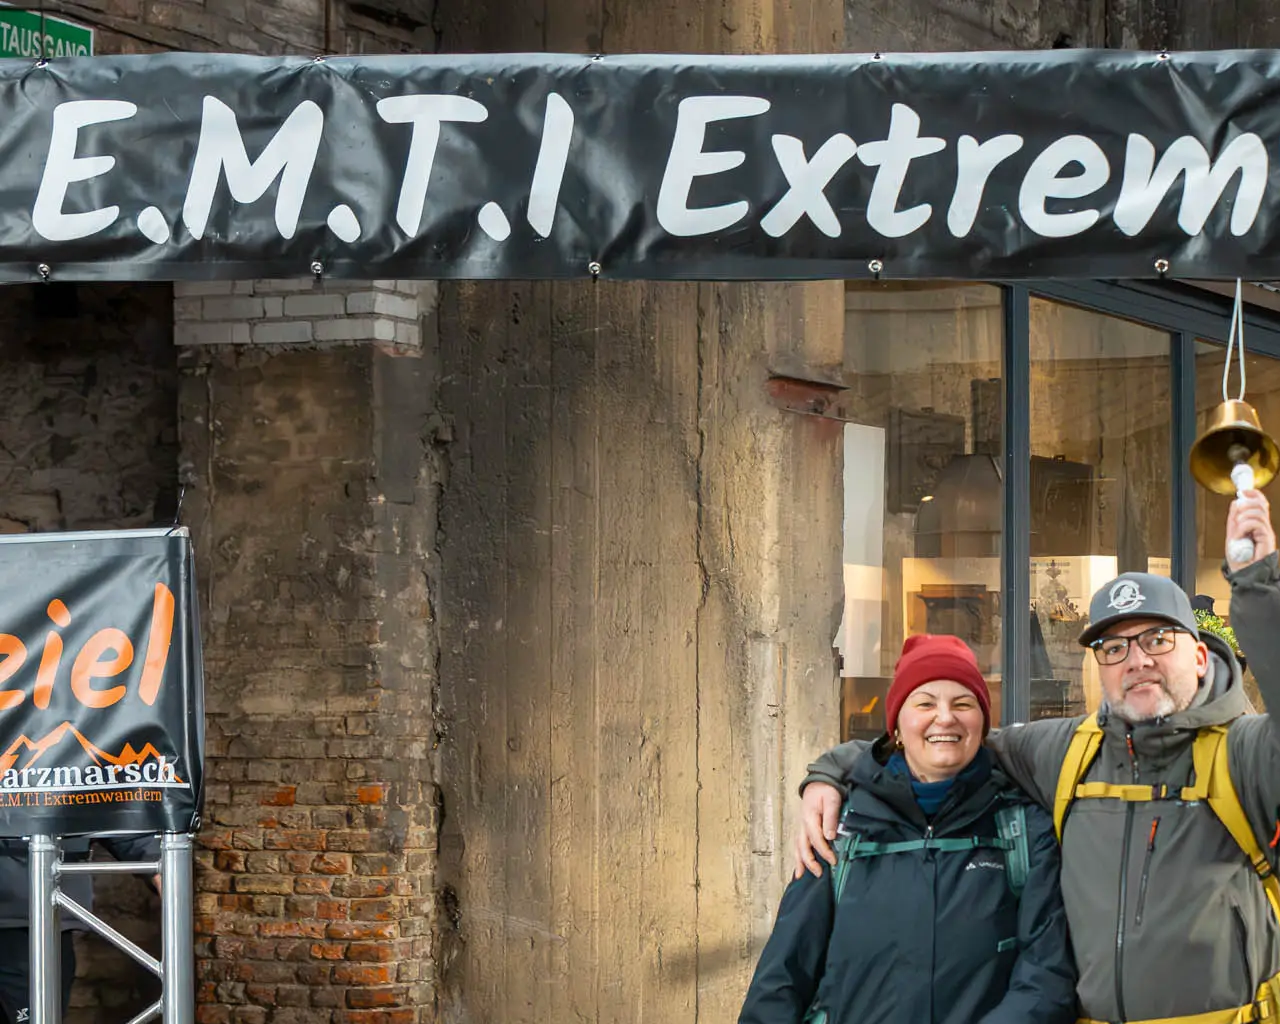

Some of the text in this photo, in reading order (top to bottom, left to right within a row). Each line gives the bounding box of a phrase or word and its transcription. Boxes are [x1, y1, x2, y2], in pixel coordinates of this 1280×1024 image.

[32, 93, 575, 244] E.M.T.I
[0, 756, 177, 788] arzmarsch
[44, 788, 162, 806] Extremwandern
